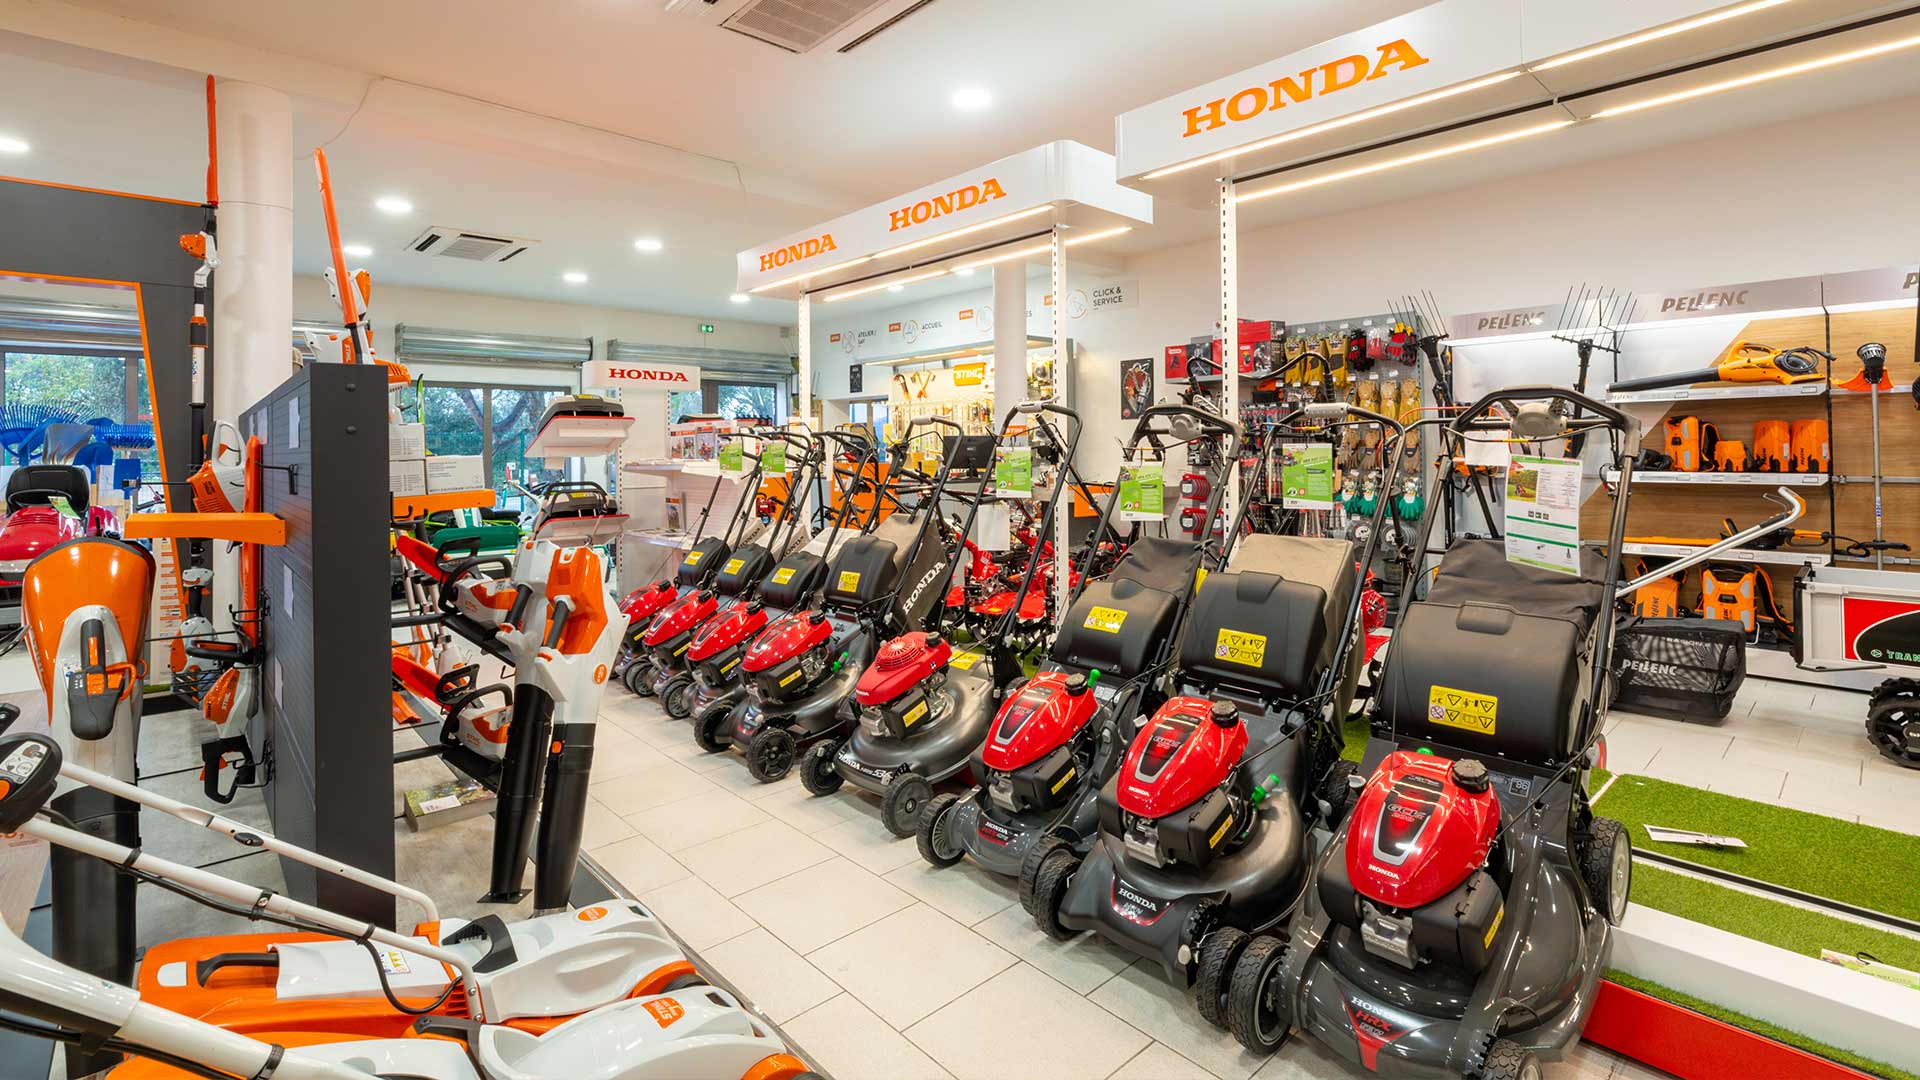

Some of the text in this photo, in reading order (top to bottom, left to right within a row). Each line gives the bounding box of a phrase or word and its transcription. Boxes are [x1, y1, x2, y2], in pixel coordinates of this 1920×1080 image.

[1182, 38, 1430, 138] HONDA
[889, 178, 1007, 232] HONDA
[759, 233, 838, 272] HONDA
[1093, 288, 1114, 298] CLICK
[1093, 296, 1123, 307] SERVICE
[1661, 290, 1749, 312] PELLENC
[922, 322, 942, 330] ACCUEIL
[608, 368, 689, 382] HONDA
[955, 368, 983, 379] STIHL
[902, 562, 946, 615] HONDA
[1622, 659, 1678, 676] PELLENC
[1368, 864, 1400, 880] HONDA
[1118, 888, 1157, 912] HONDA
[1356, 1010, 1392, 1032] HRX
